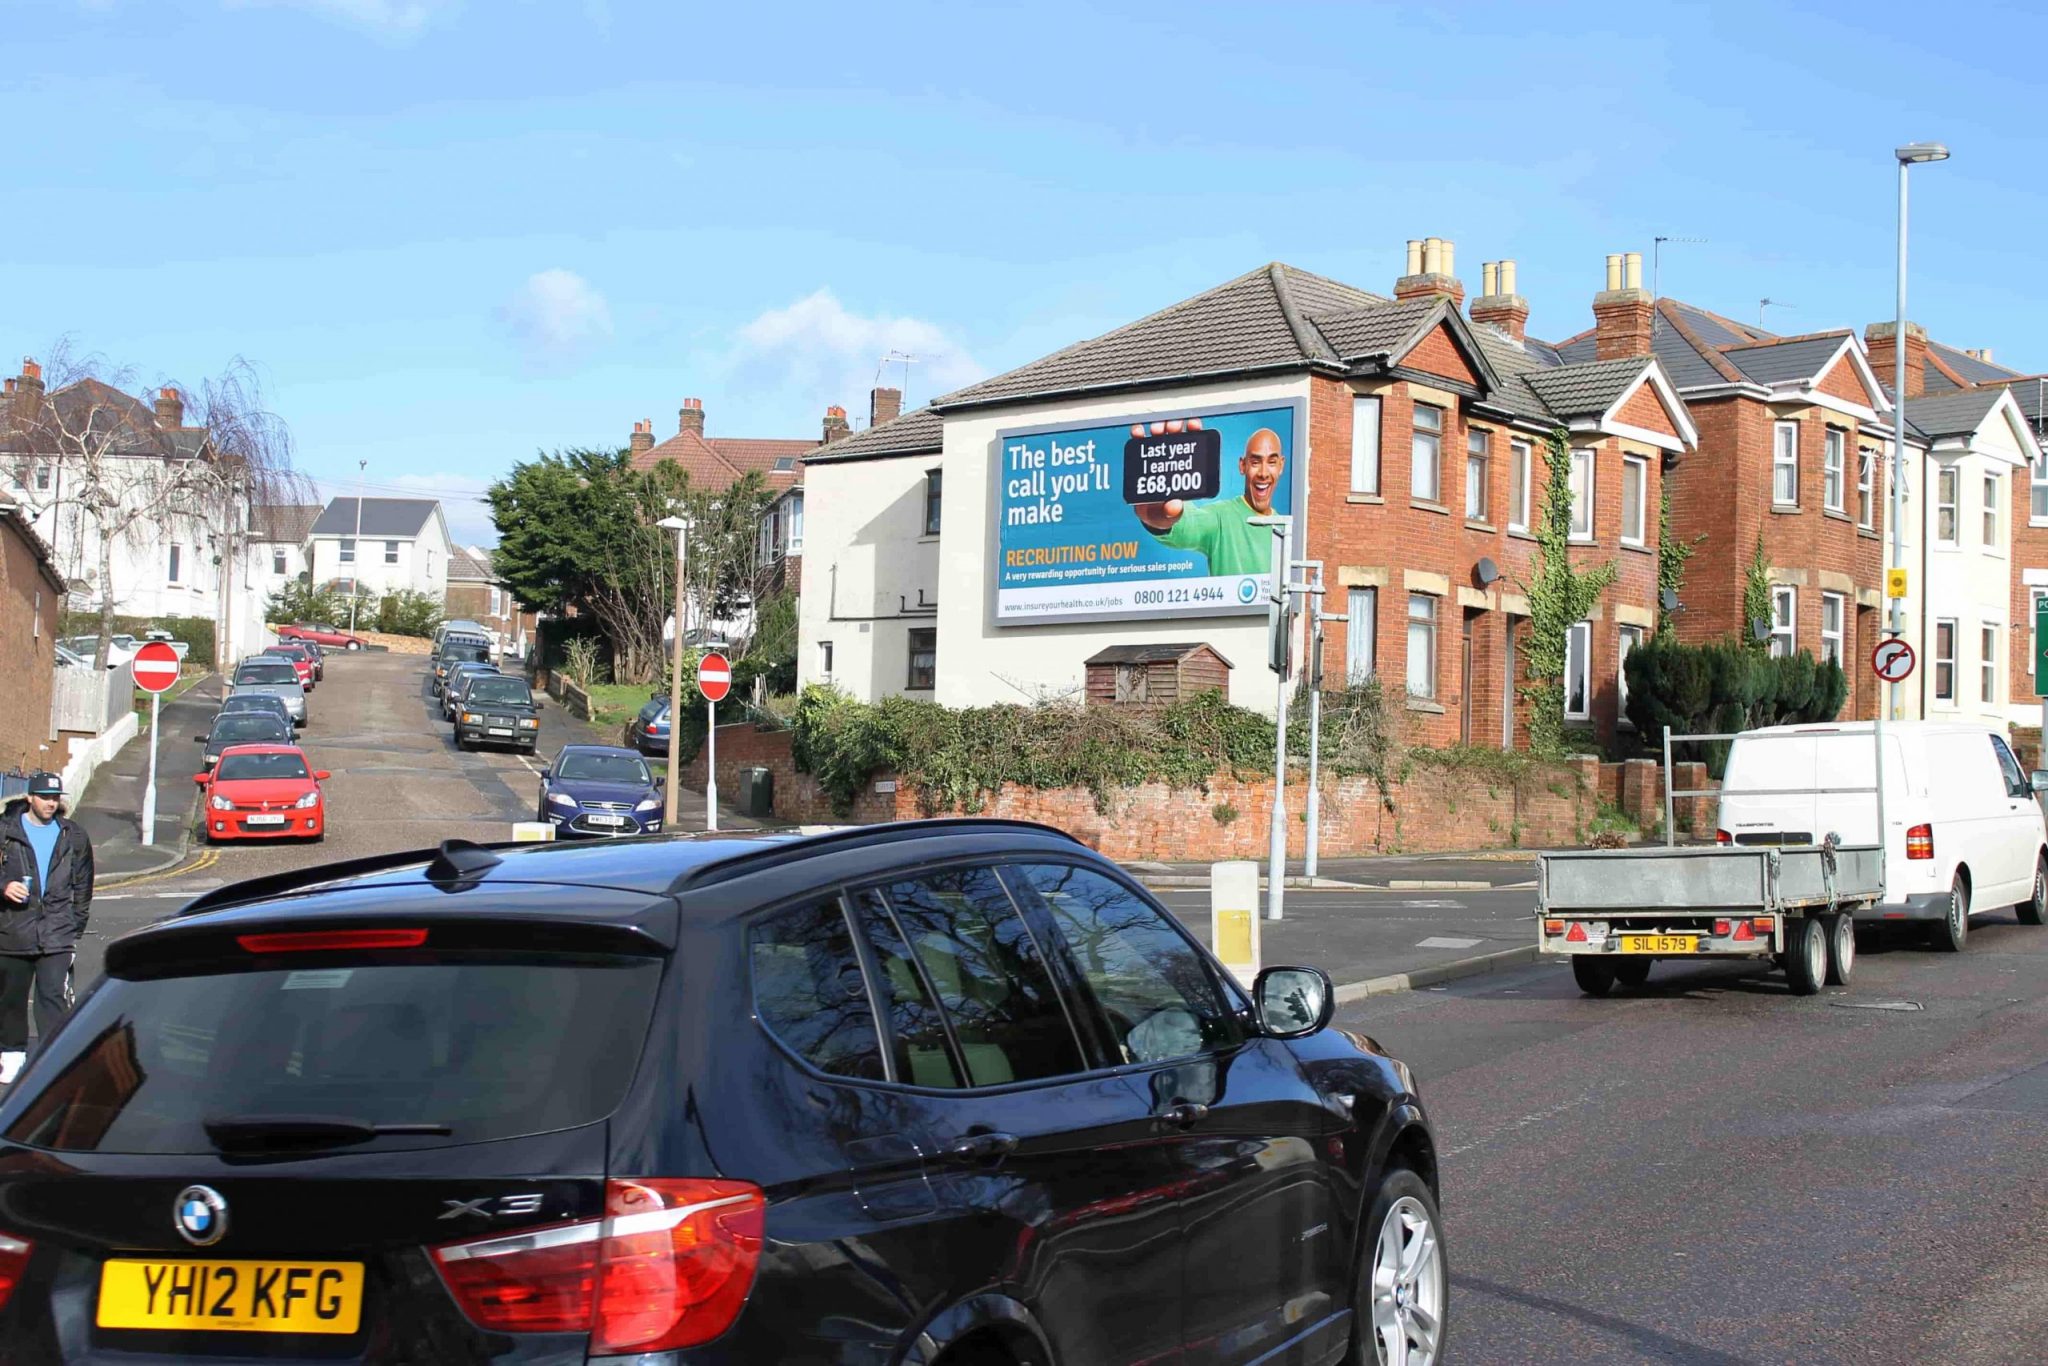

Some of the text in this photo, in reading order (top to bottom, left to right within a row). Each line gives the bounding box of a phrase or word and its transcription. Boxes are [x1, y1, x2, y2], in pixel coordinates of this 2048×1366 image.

[1008, 440, 1096, 470] The best
[1140, 442, 1197, 459] Last year
[1143, 455, 1193, 474] I earned
[1008, 463, 1110, 501] call you'll
[1136, 471, 1202, 496] £68,000
[1008, 497, 1063, 525] make
[1006, 541, 1138, 567] RECRUITING NOW
[1005, 560, 1193, 582] A very rewarding opportunity for serious sales people
[1004, 597, 1123, 612] www.insureyourhealth.co.uk/jobs
[1134, 587, 1224, 604] 0800 121 4944
[1633, 938, 1687, 951] SIL 1579
[437, 1193, 545, 1219] X3
[144, 1265, 344, 1320] YH12 KFG
